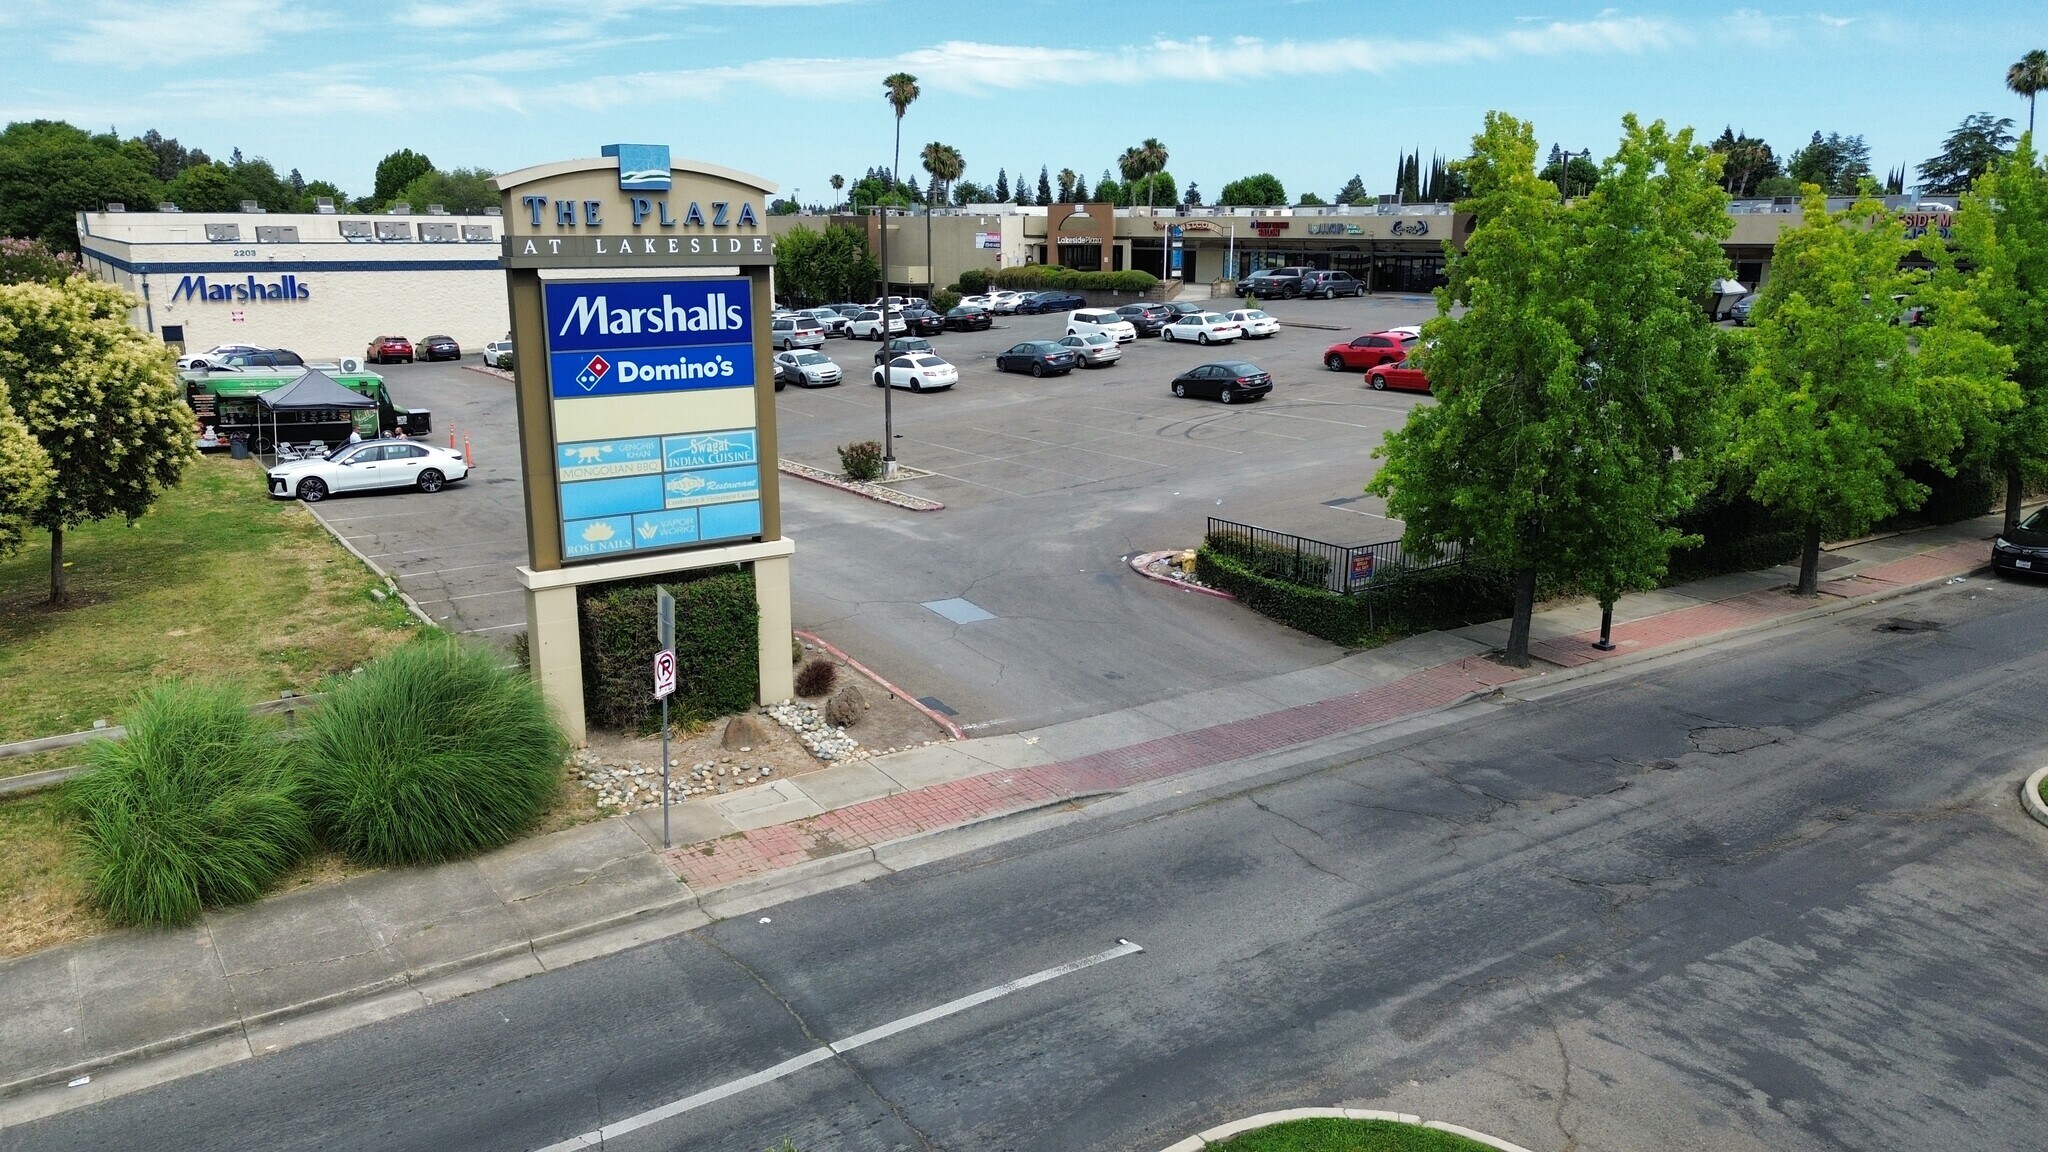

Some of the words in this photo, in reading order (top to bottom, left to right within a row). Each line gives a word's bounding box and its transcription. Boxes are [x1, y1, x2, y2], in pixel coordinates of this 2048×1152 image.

[522, 195, 604, 226] THE
[631, 196, 759, 226] PLAZA
[233, 249, 257, 257] 2203
[523, 239, 562, 255] AT
[596, 237, 764, 255] LAKESIDE
[171, 274, 310, 302] Marshalls
[559, 293, 744, 337] Marshalls
[617, 354, 734, 383] Domino's
[618, 441, 655, 452] GENGHIS
[626, 449, 651, 459] KHAN
[690, 439, 729, 455] Swagat
[669, 457, 706, 468] INDIAN
[708, 451, 751, 464] CUISINE
[563, 463, 634, 479] MONGOLIAN
[636, 461, 658, 472] BBQ
[706, 479, 757, 492] Restaurant
[659, 525, 695, 536] WORKZ
[660, 517, 694, 528] VAPOR
[567, 544, 598, 555] ROSE
[599, 538, 632, 550] NAILS
